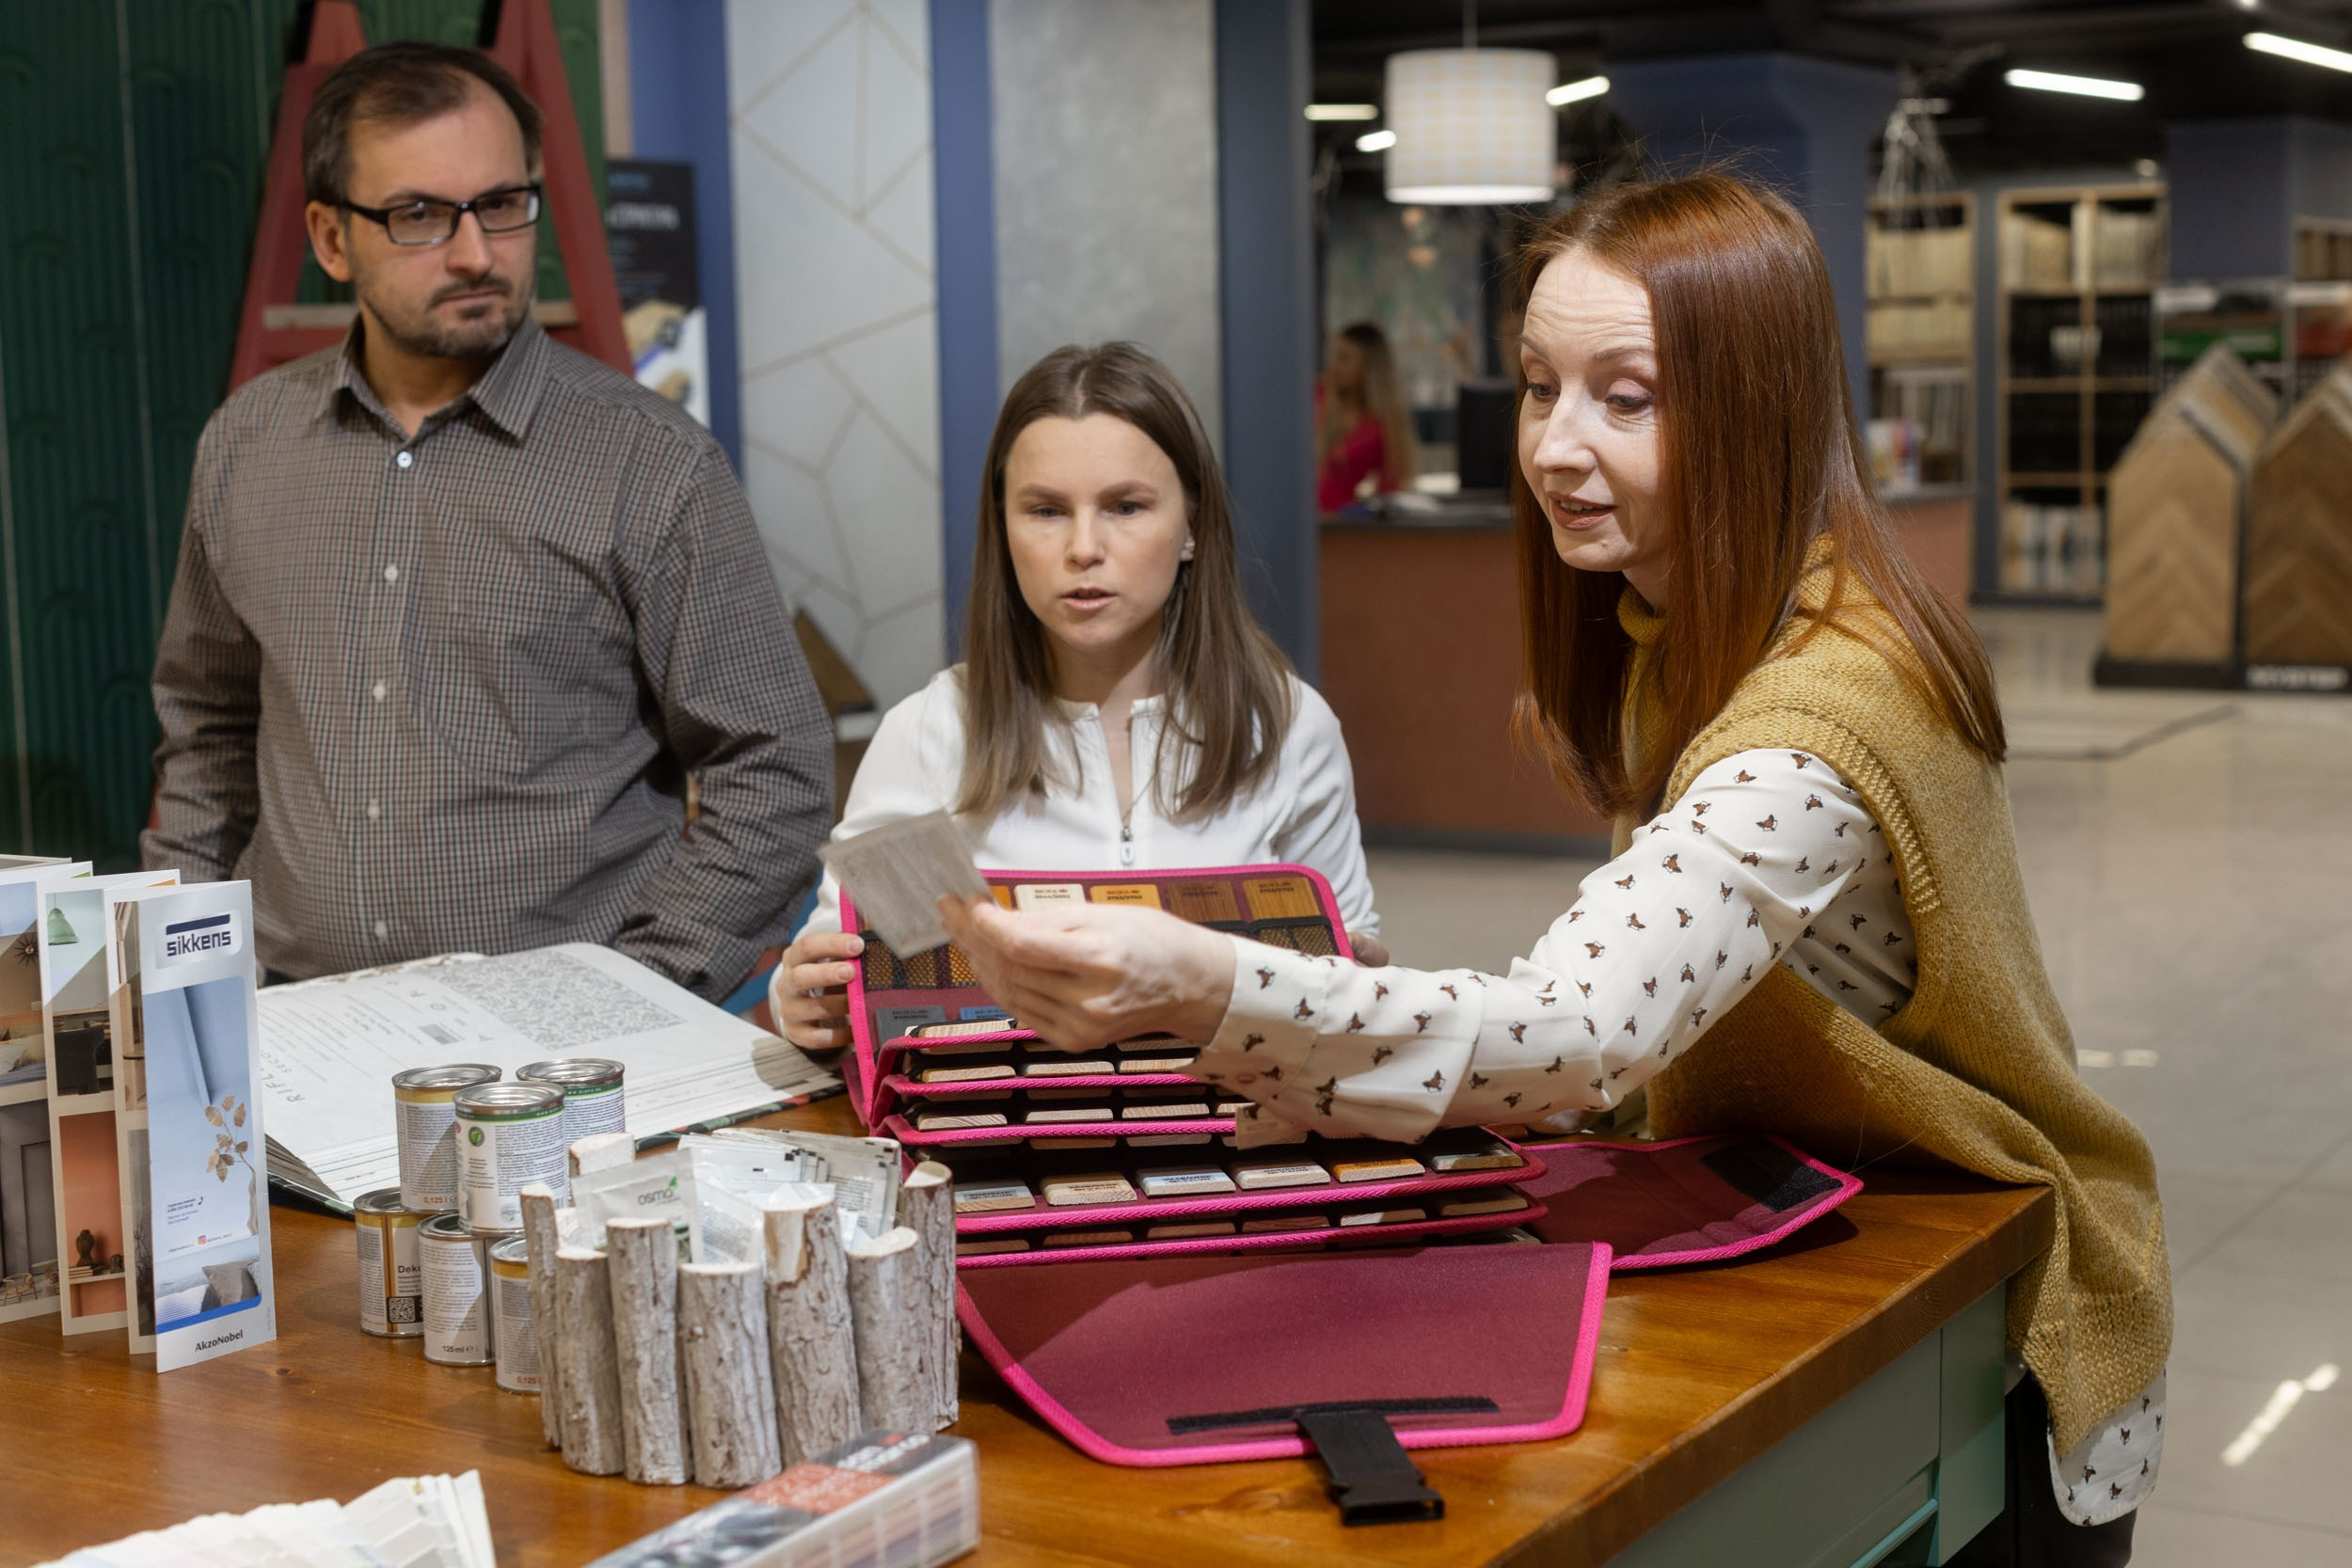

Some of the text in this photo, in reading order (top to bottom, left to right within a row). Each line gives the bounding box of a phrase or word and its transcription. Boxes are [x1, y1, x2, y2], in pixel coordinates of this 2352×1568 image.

[167, 930, 231, 958] sikkens
[260, 1068, 307, 1103] RIFL
[637, 1188, 674, 1206] osmo
[195, 1329, 244, 1353] AkzoNobel
